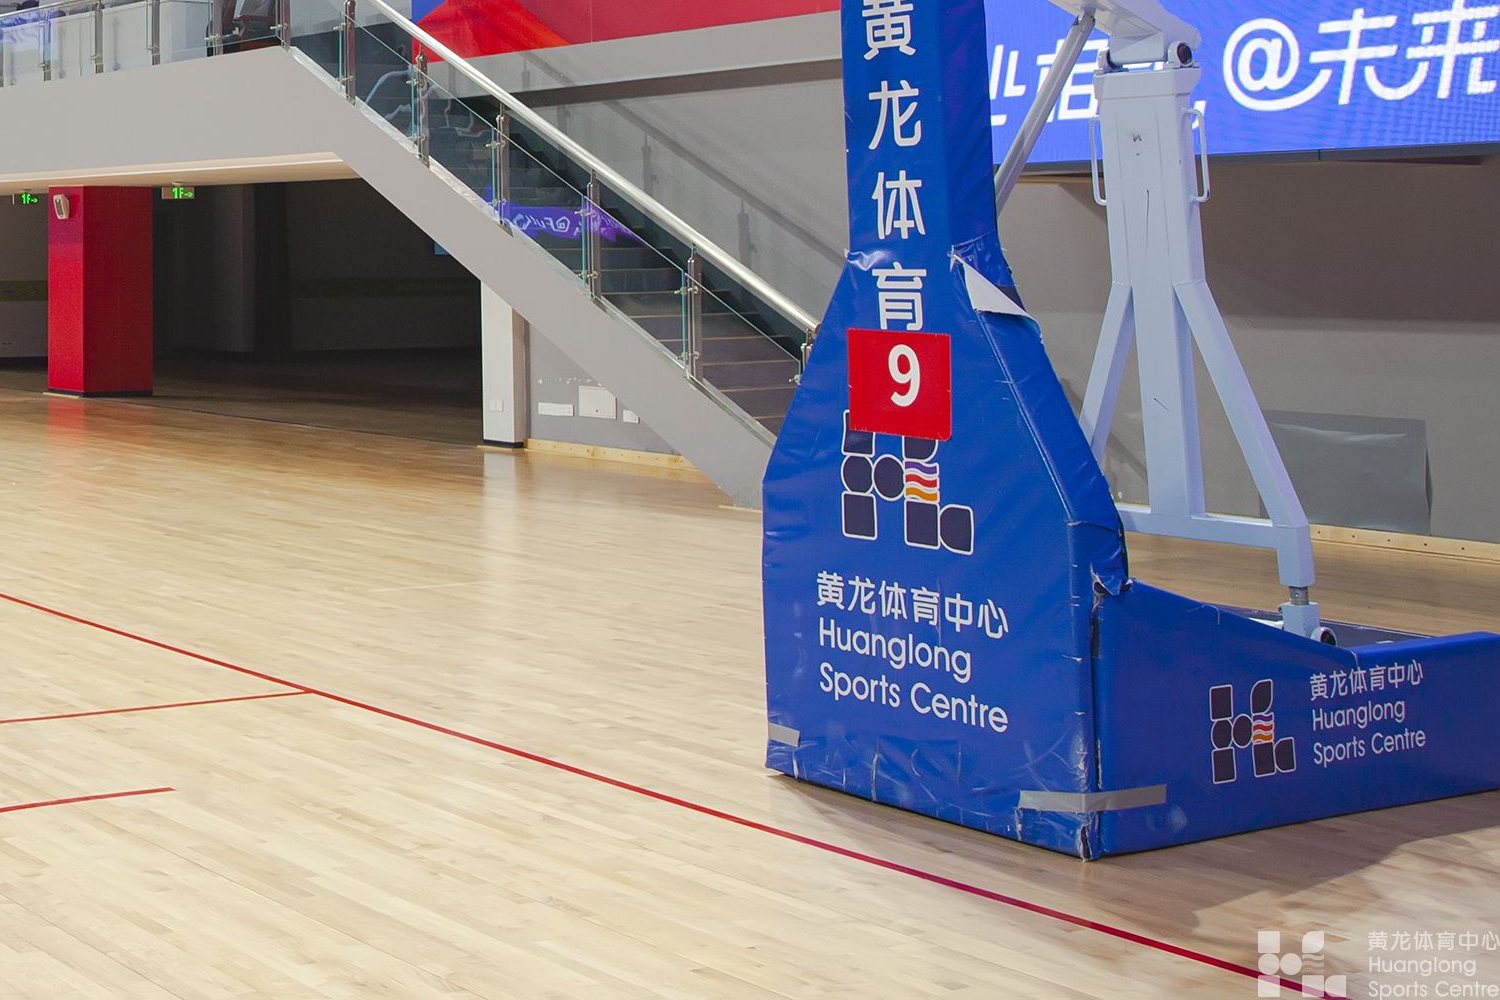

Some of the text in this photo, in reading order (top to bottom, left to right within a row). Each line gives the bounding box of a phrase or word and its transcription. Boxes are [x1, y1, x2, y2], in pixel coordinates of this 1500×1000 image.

[887, 344, 921, 407] 9
[816, 571, 1009, 640] 黄龙体育中心
[818, 616, 971, 684] Huanglong
[1309, 659, 1424, 701] 黄龙体育中心
[819, 661, 1009, 733] Sports Centre
[1311, 700, 1406, 731] Huanglong
[1313, 728, 1426, 768] Sports Centre
